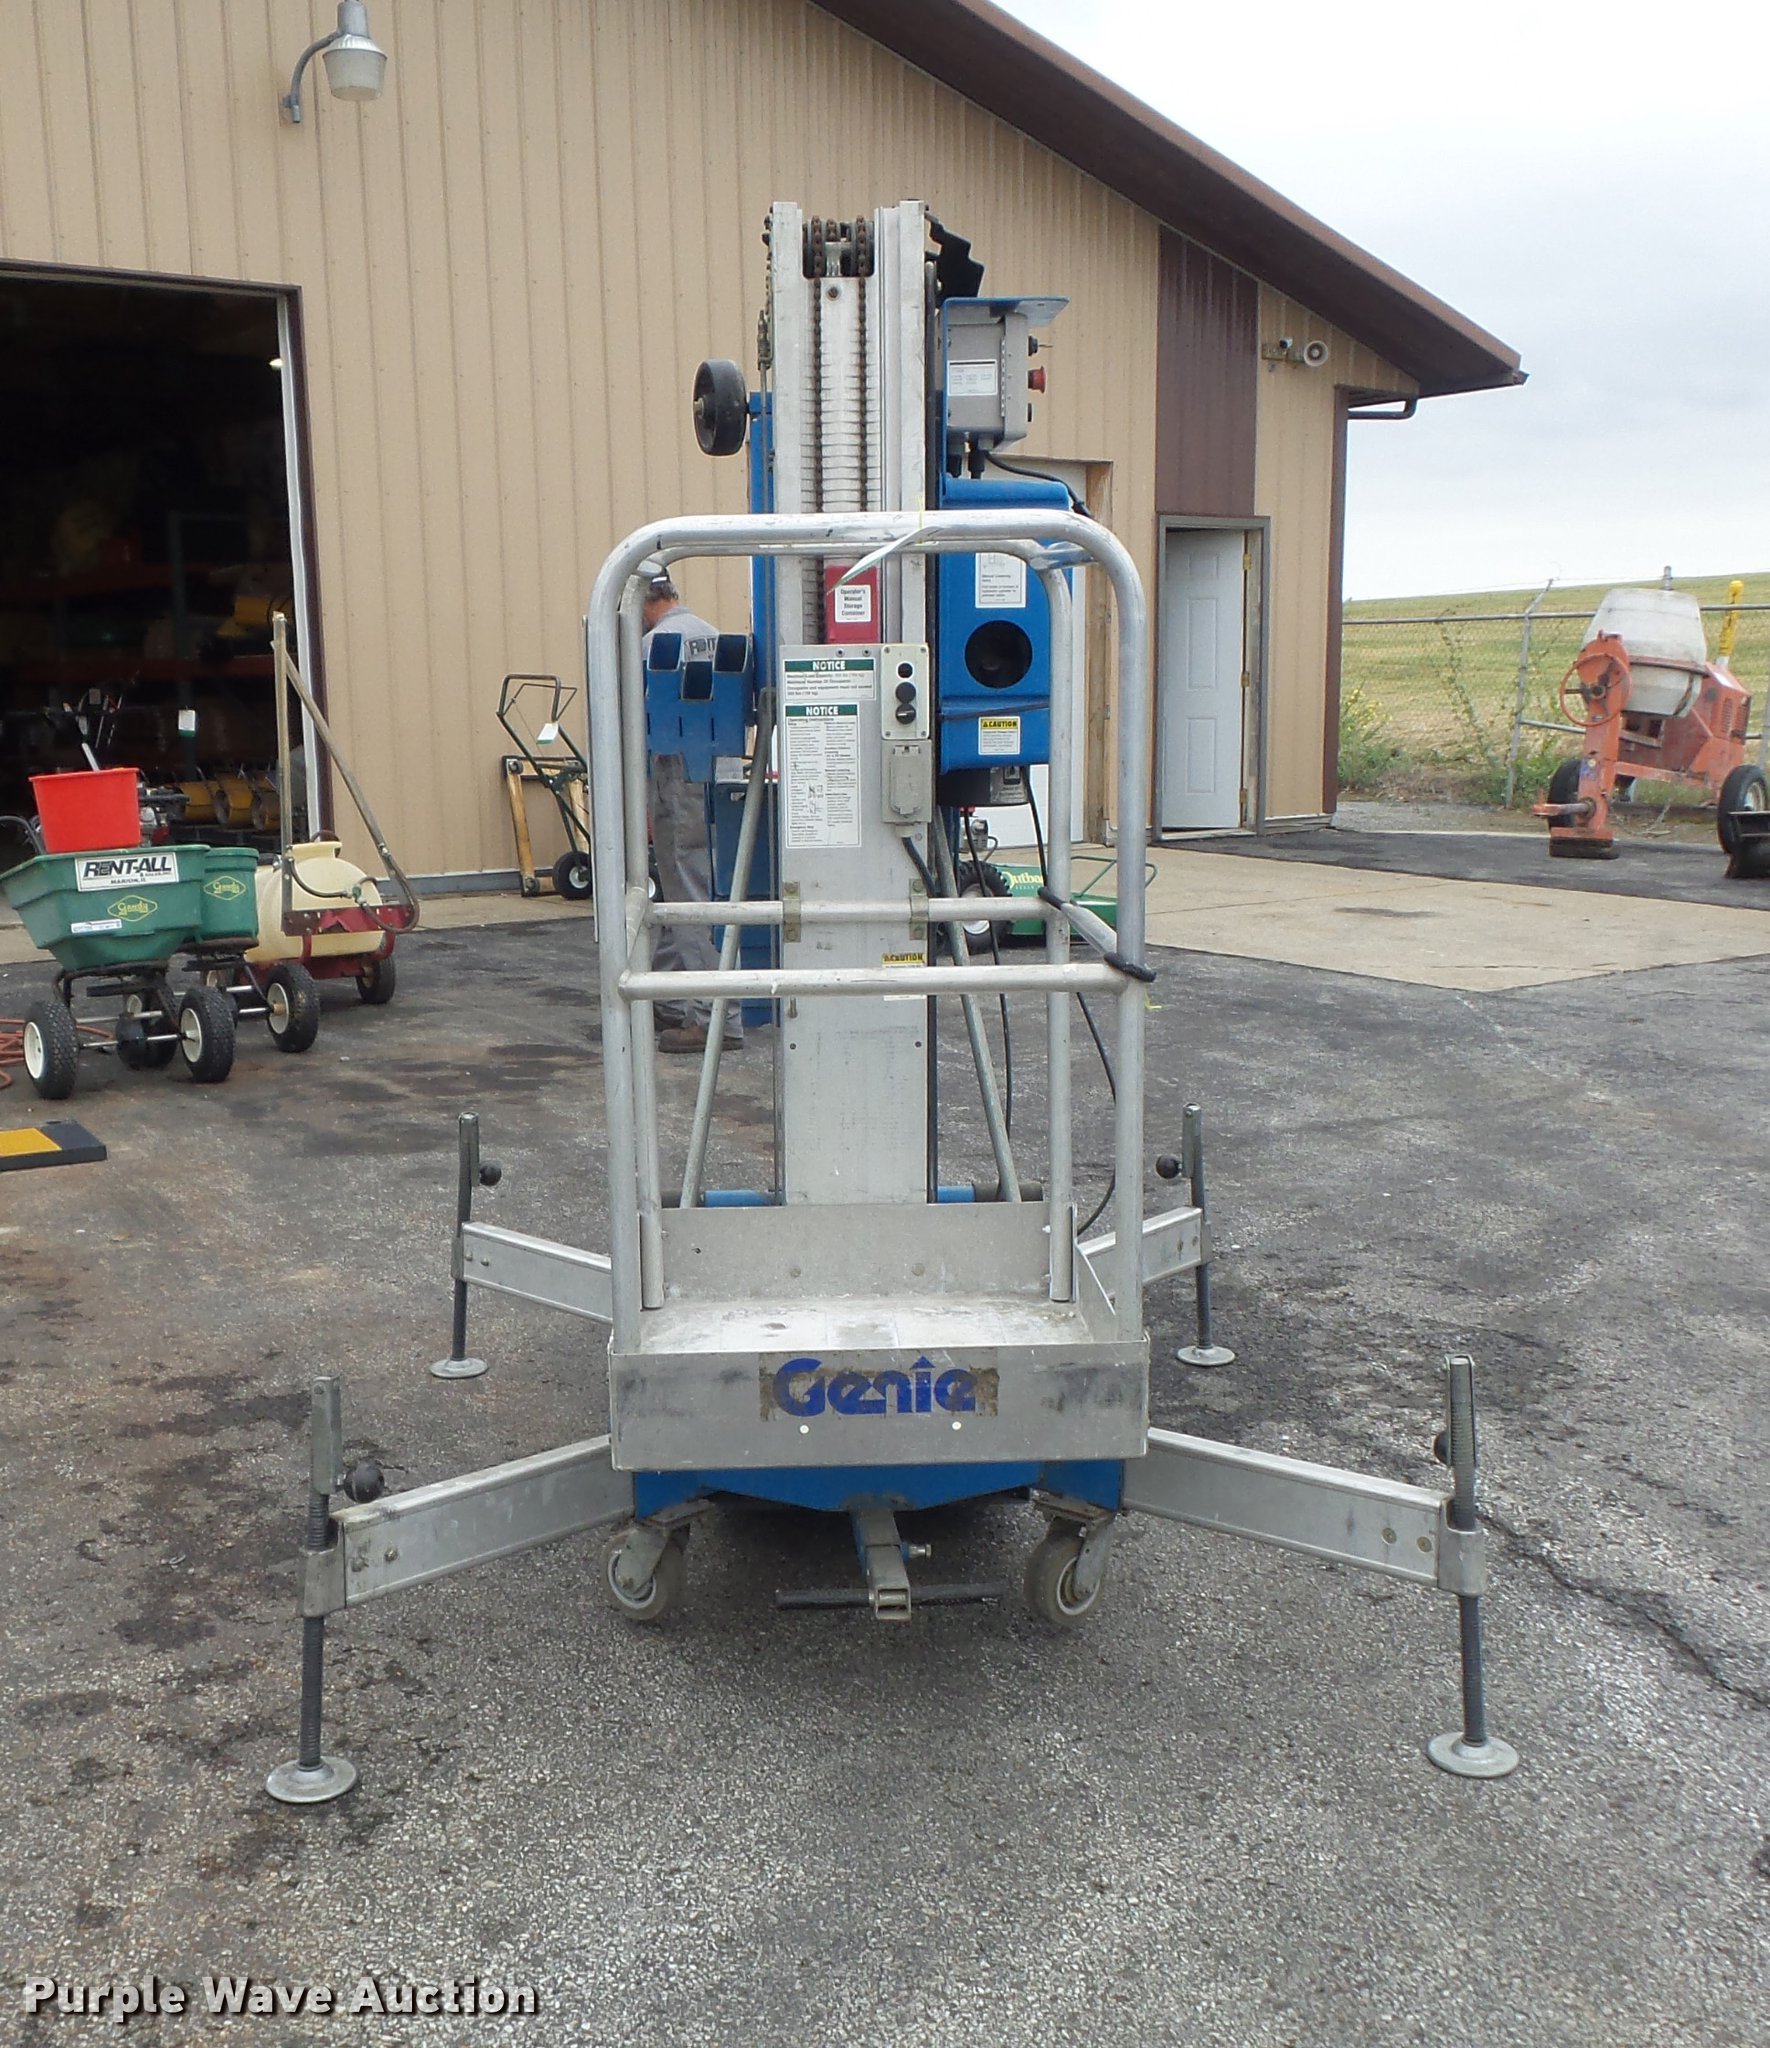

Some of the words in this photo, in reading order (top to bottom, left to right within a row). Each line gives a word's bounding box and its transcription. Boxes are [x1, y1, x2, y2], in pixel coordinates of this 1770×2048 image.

[812, 660, 846, 670] NOTICE
[805, 706, 839, 716] NOTICE
[989, 720, 1017, 728] CAUTION
[84, 856, 172, 877] RENT-ALL
[1001, 871, 1044, 889] Outba
[891, 952, 924, 962] CAUTION
[772, 1355, 977, 1417] Genie
